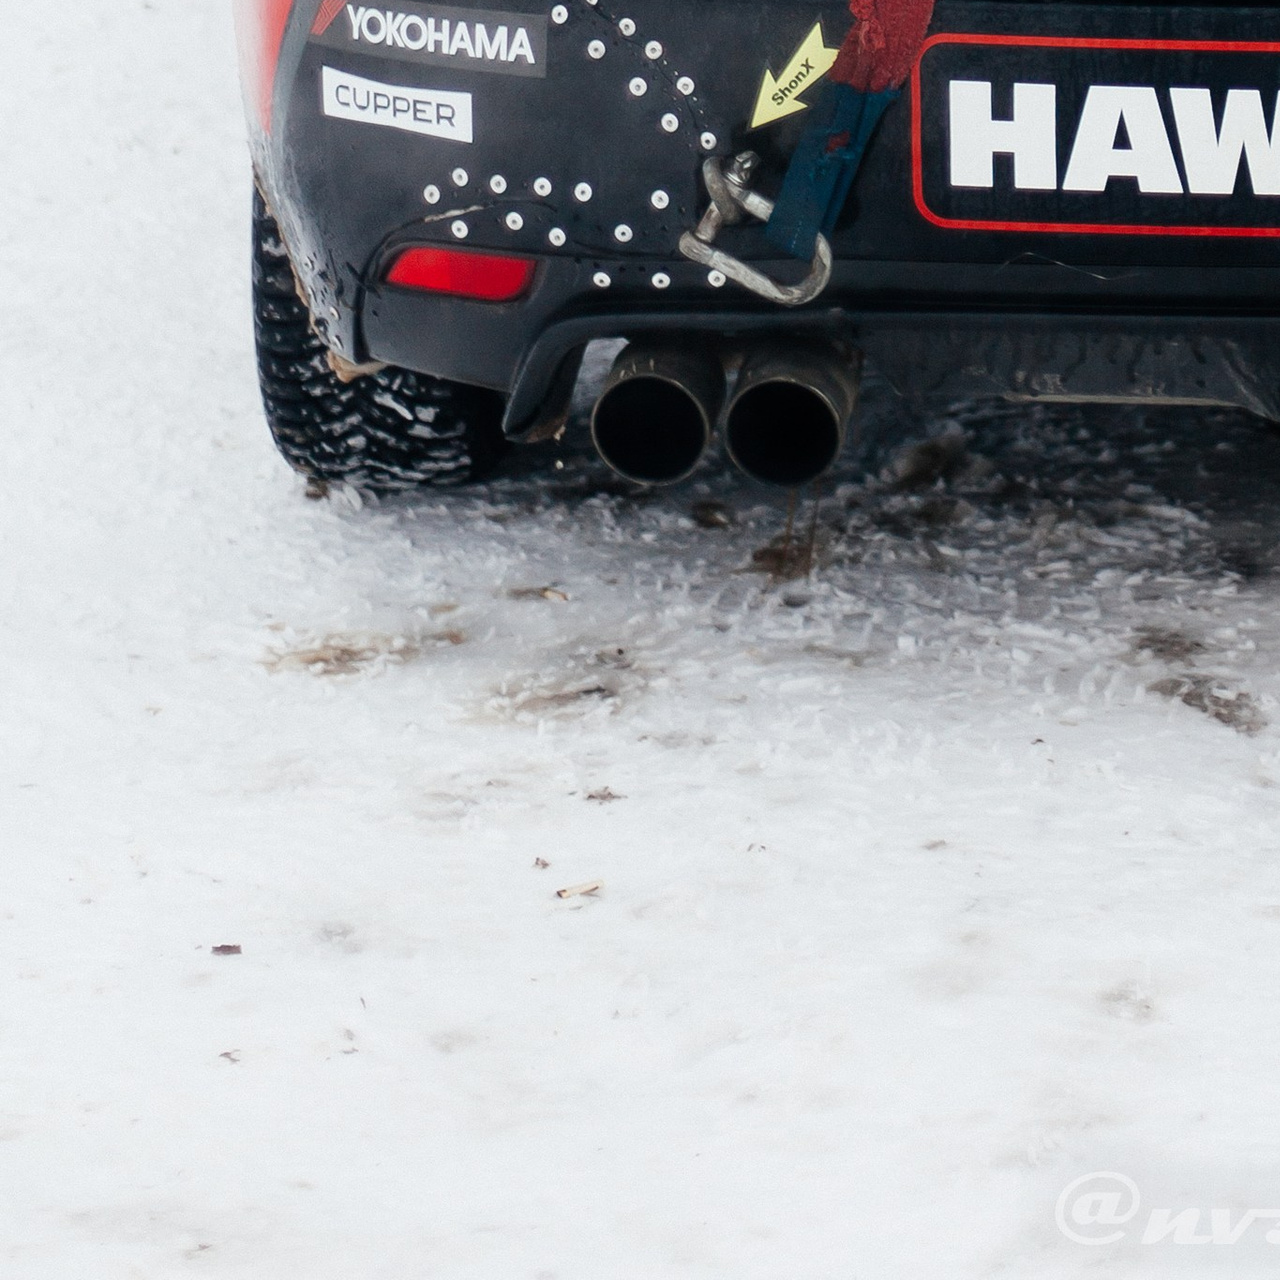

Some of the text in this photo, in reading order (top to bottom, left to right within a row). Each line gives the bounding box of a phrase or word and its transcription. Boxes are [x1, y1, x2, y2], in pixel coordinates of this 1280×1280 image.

[345, 4, 536, 66] YOKOHAMA
[334, 83, 457, 127] CUPPER
[770, 56, 817, 109] ShonX
